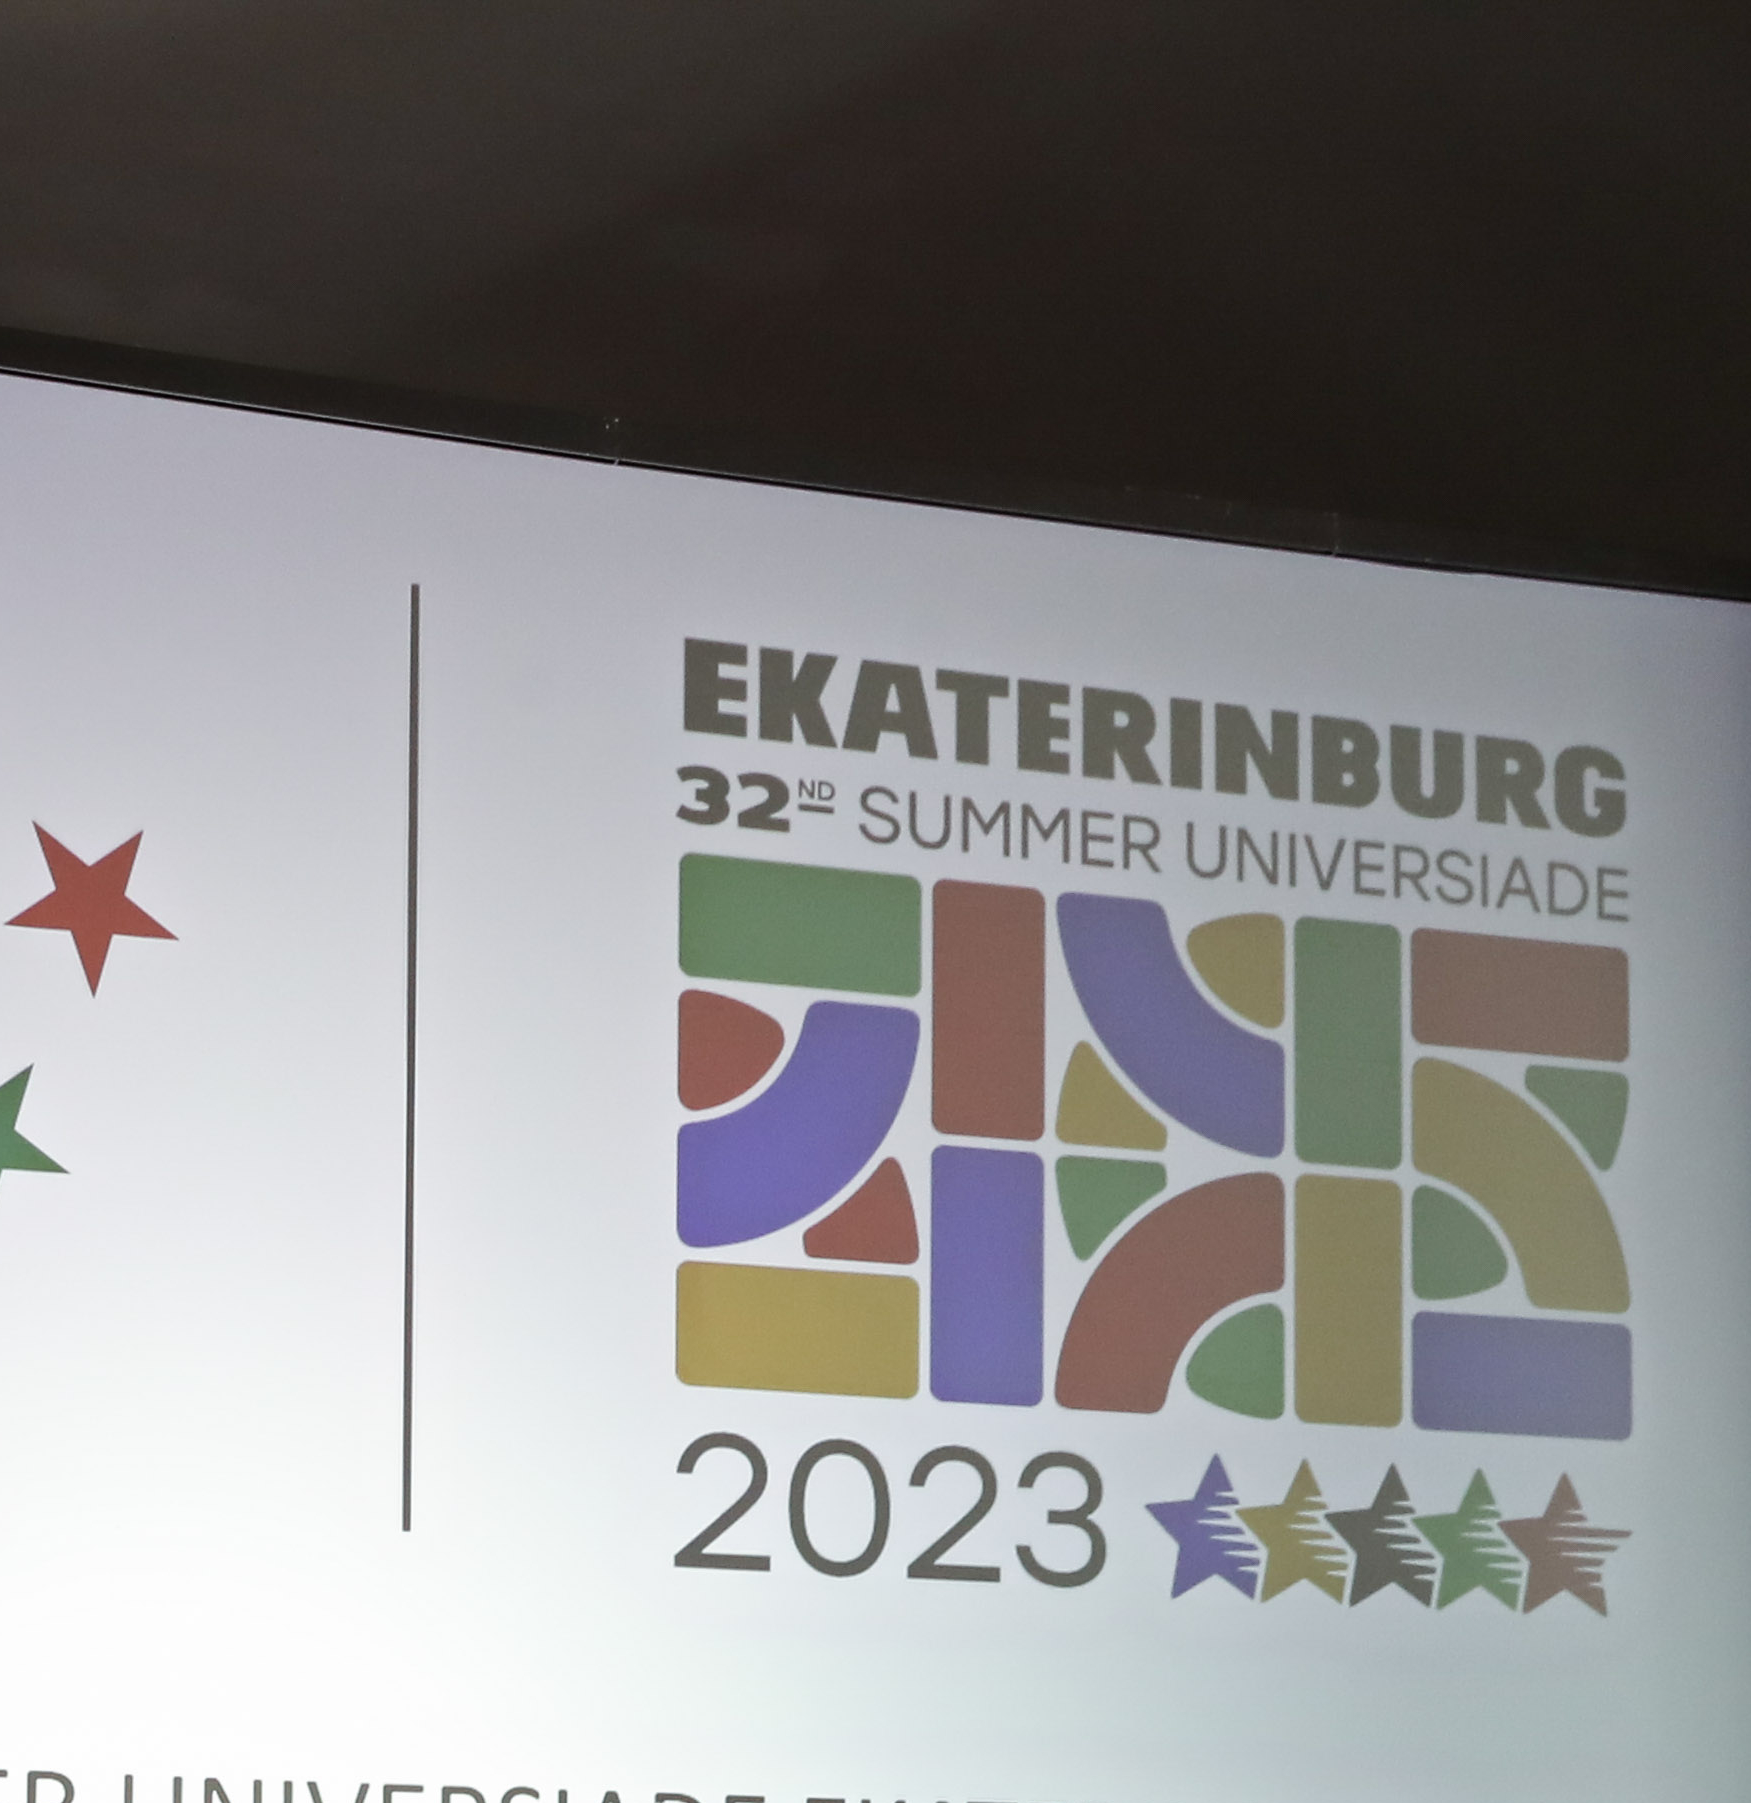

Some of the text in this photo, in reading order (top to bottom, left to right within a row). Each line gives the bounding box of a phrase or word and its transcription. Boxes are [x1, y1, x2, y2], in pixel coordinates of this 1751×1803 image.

[682, 637, 1627, 838] EKATERINBURG
[857, 786, 1162, 873] SUMMER
[1185, 833, 1631, 923] UNIVERSIADE
[674, 1431, 1107, 1588] 2023
